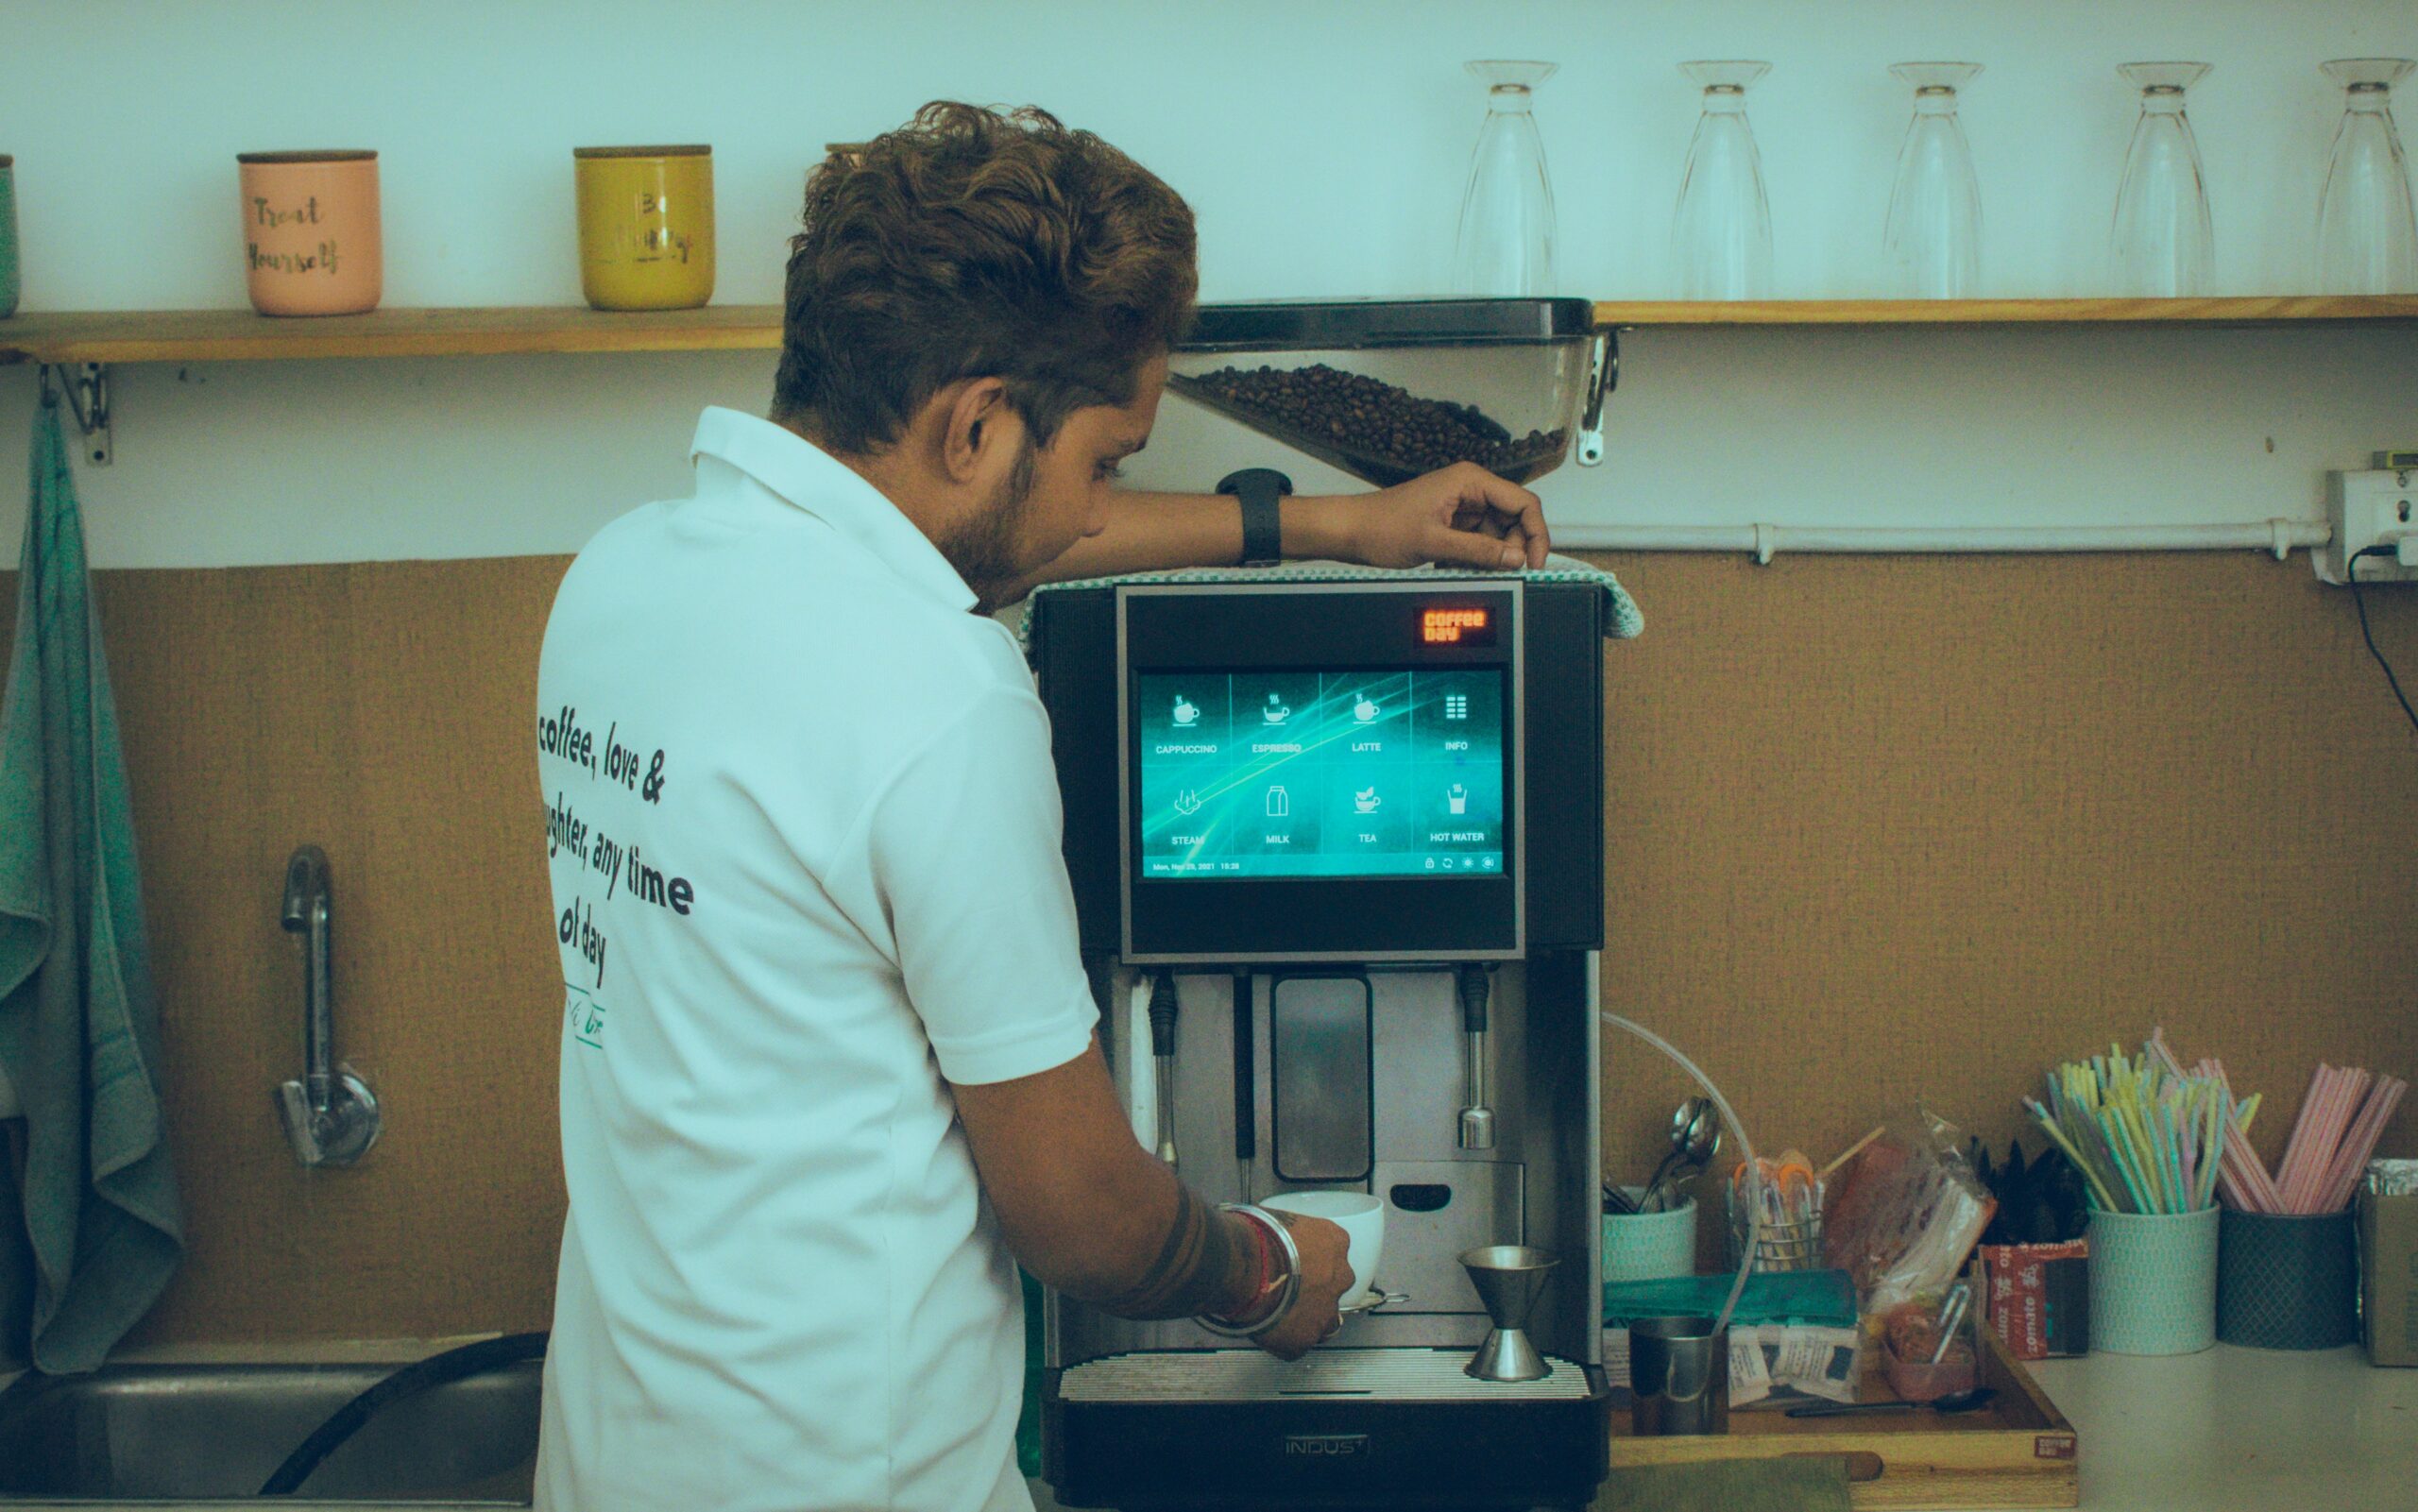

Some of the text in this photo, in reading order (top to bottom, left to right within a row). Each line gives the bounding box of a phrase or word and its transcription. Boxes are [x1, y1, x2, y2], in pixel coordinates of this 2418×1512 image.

[254, 196, 321, 227] Treat
[248, 240, 340, 274] Yourself
[1155, 743, 1218, 755] CAPPUCCINO
[1252, 742, 1303, 754] ESPRESSO
[1352, 741, 1382, 753] LATTE
[1445, 740, 1469, 751] INFO
[539, 705, 665, 805] coffee, love &
[1171, 836, 1205, 846] STEAM
[1266, 834, 1290, 844] MILK
[1358, 833, 1377, 843] TEA
[1430, 832, 1486, 842] HOT WATER
[592, 832, 623, 900] any
[627, 844, 694, 916] time
[582, 903, 606, 992] day
[2024, 1296, 2037, 1352] zomato
